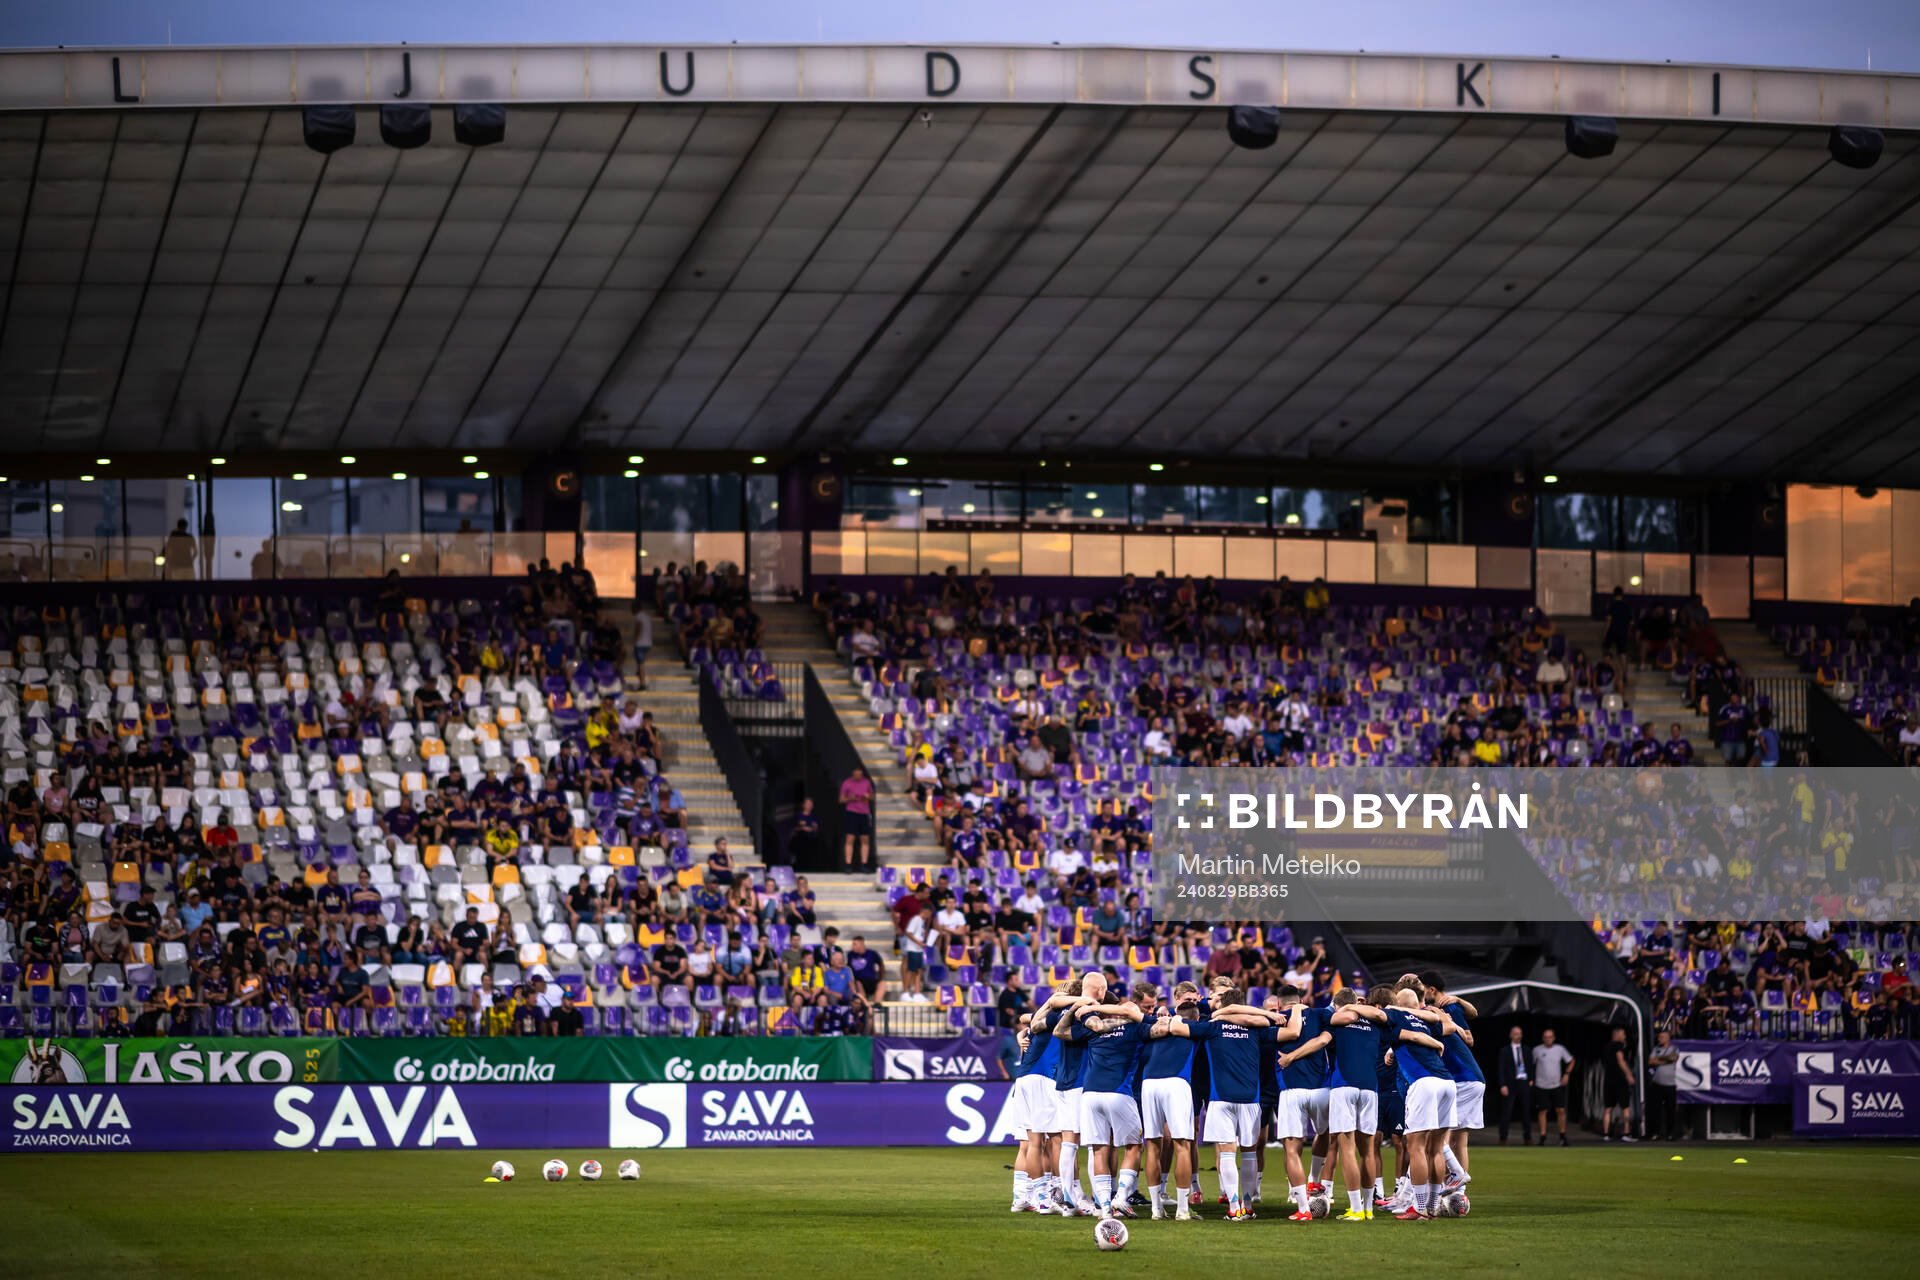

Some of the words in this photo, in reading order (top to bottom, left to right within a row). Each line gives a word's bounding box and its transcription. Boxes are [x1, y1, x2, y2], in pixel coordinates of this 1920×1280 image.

[1222, 1031, 1249, 1039] stadium
[430, 1056, 555, 1082] otpbanka
[700, 1056, 820, 1081] otpbanka
[930, 1056, 988, 1075] SAVA
[1717, 1058, 1772, 1077] SAVA
[1841, 1058, 1893, 1074] SAVA
[702, 1090, 815, 1126] SAVA
[1851, 1091, 1905, 1110] SAVA
[13, 1093, 132, 1130] SAVA
[273, 1085, 478, 1148] SAVA
[13, 1133, 132, 1146] ZAVAROVALNICA
[703, 1129, 815, 1142] ZAVAROVALNICA
